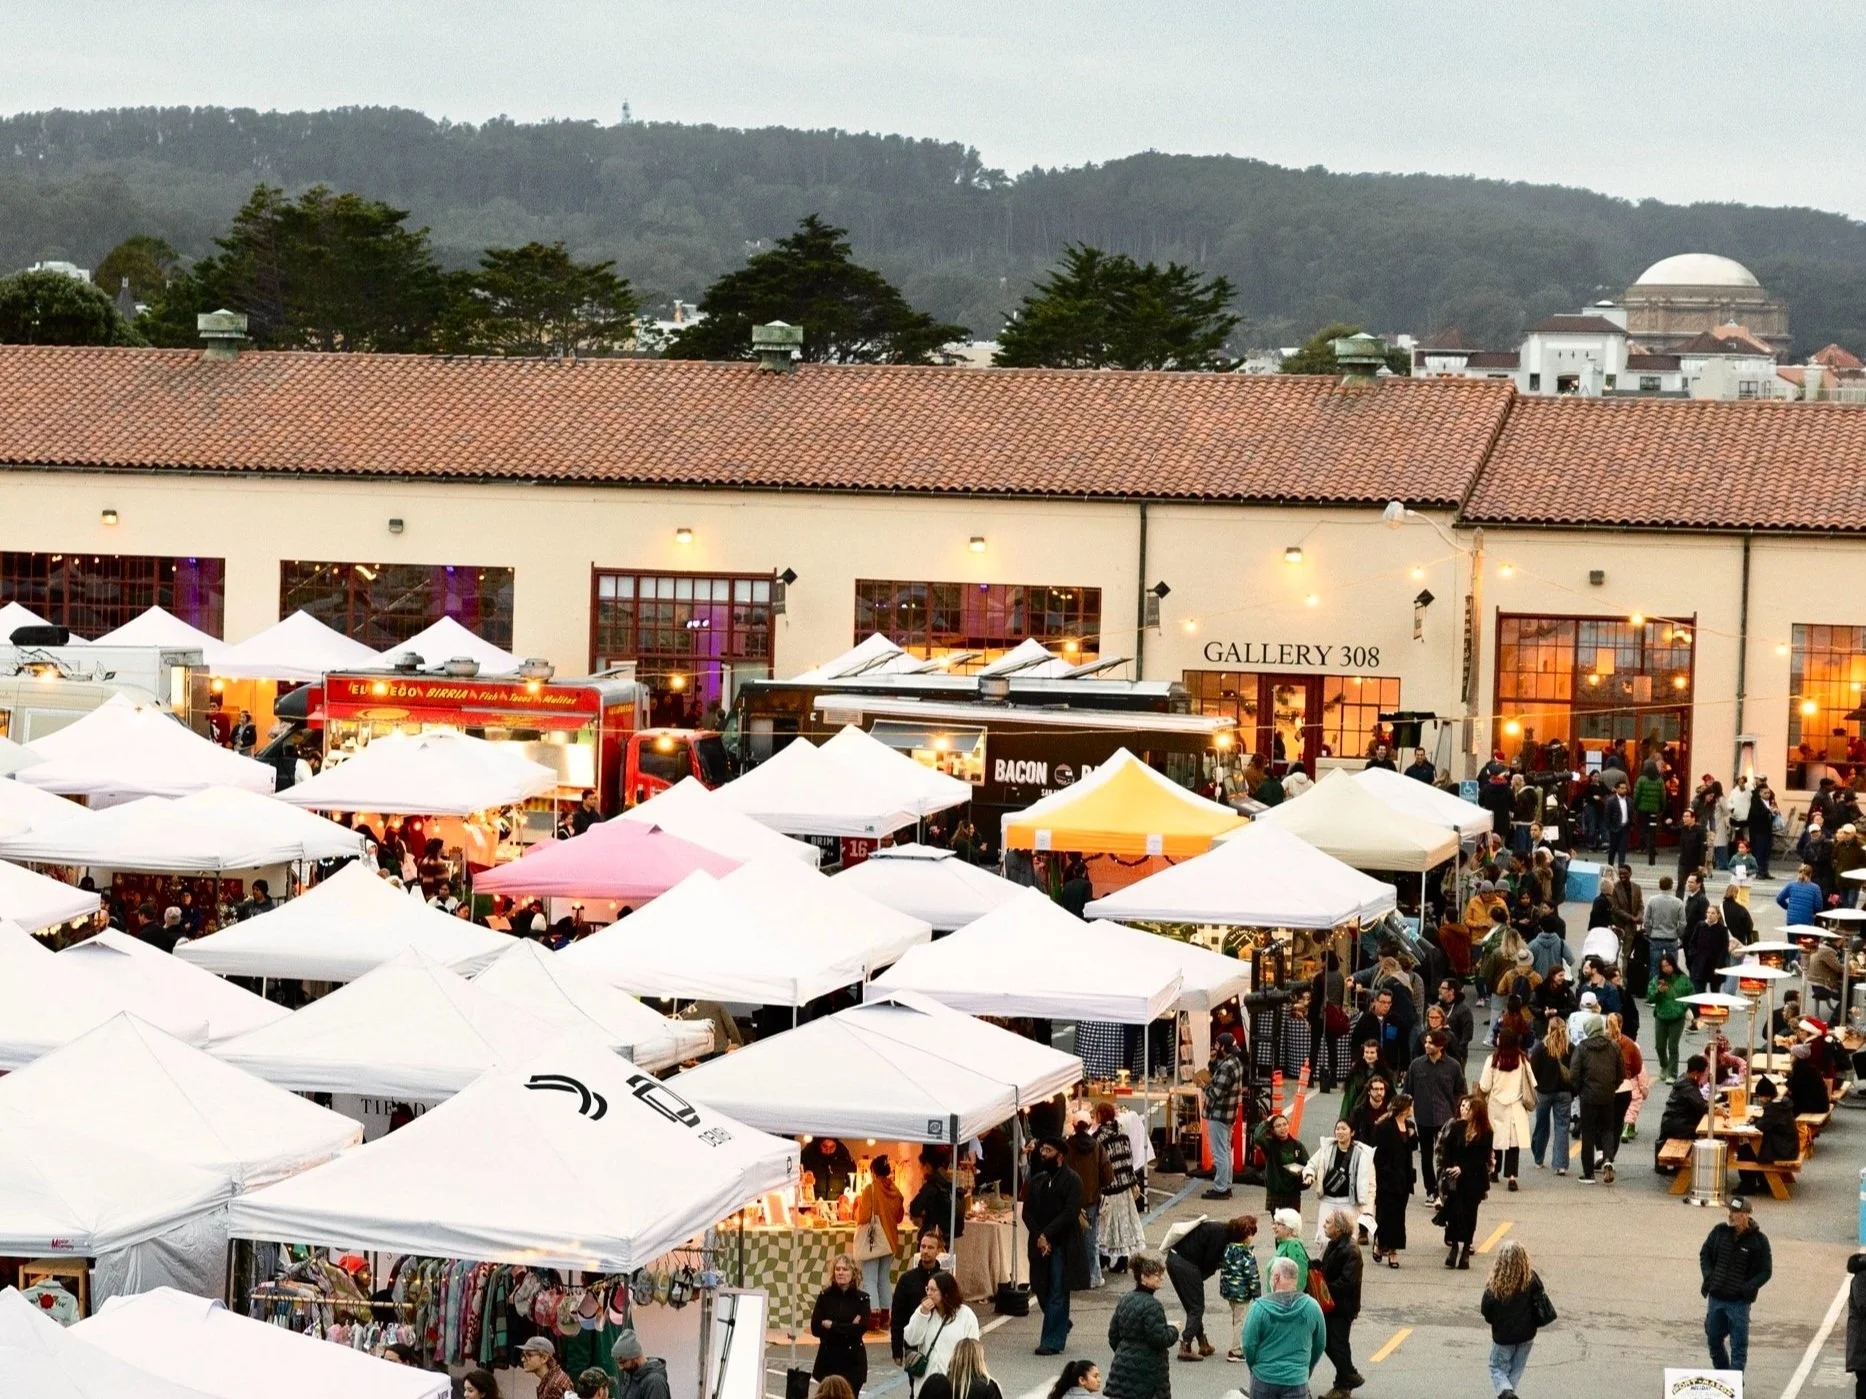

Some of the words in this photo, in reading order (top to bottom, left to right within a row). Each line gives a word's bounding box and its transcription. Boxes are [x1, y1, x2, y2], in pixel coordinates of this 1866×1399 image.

[1203, 641, 1333, 666] GALLERY
[1339, 645, 1380, 668] 308
[351, 684, 367, 695] EL
[425, 687, 468, 699] BIRRIA
[478, 691, 498, 701] Fish
[542, 694, 577, 705] Mulitas
[994, 758, 1048, 786] BACON
[810, 836, 834, 847] BRIM
[849, 840, 868, 857] 16
[360, 1097, 437, 1118] TIED
